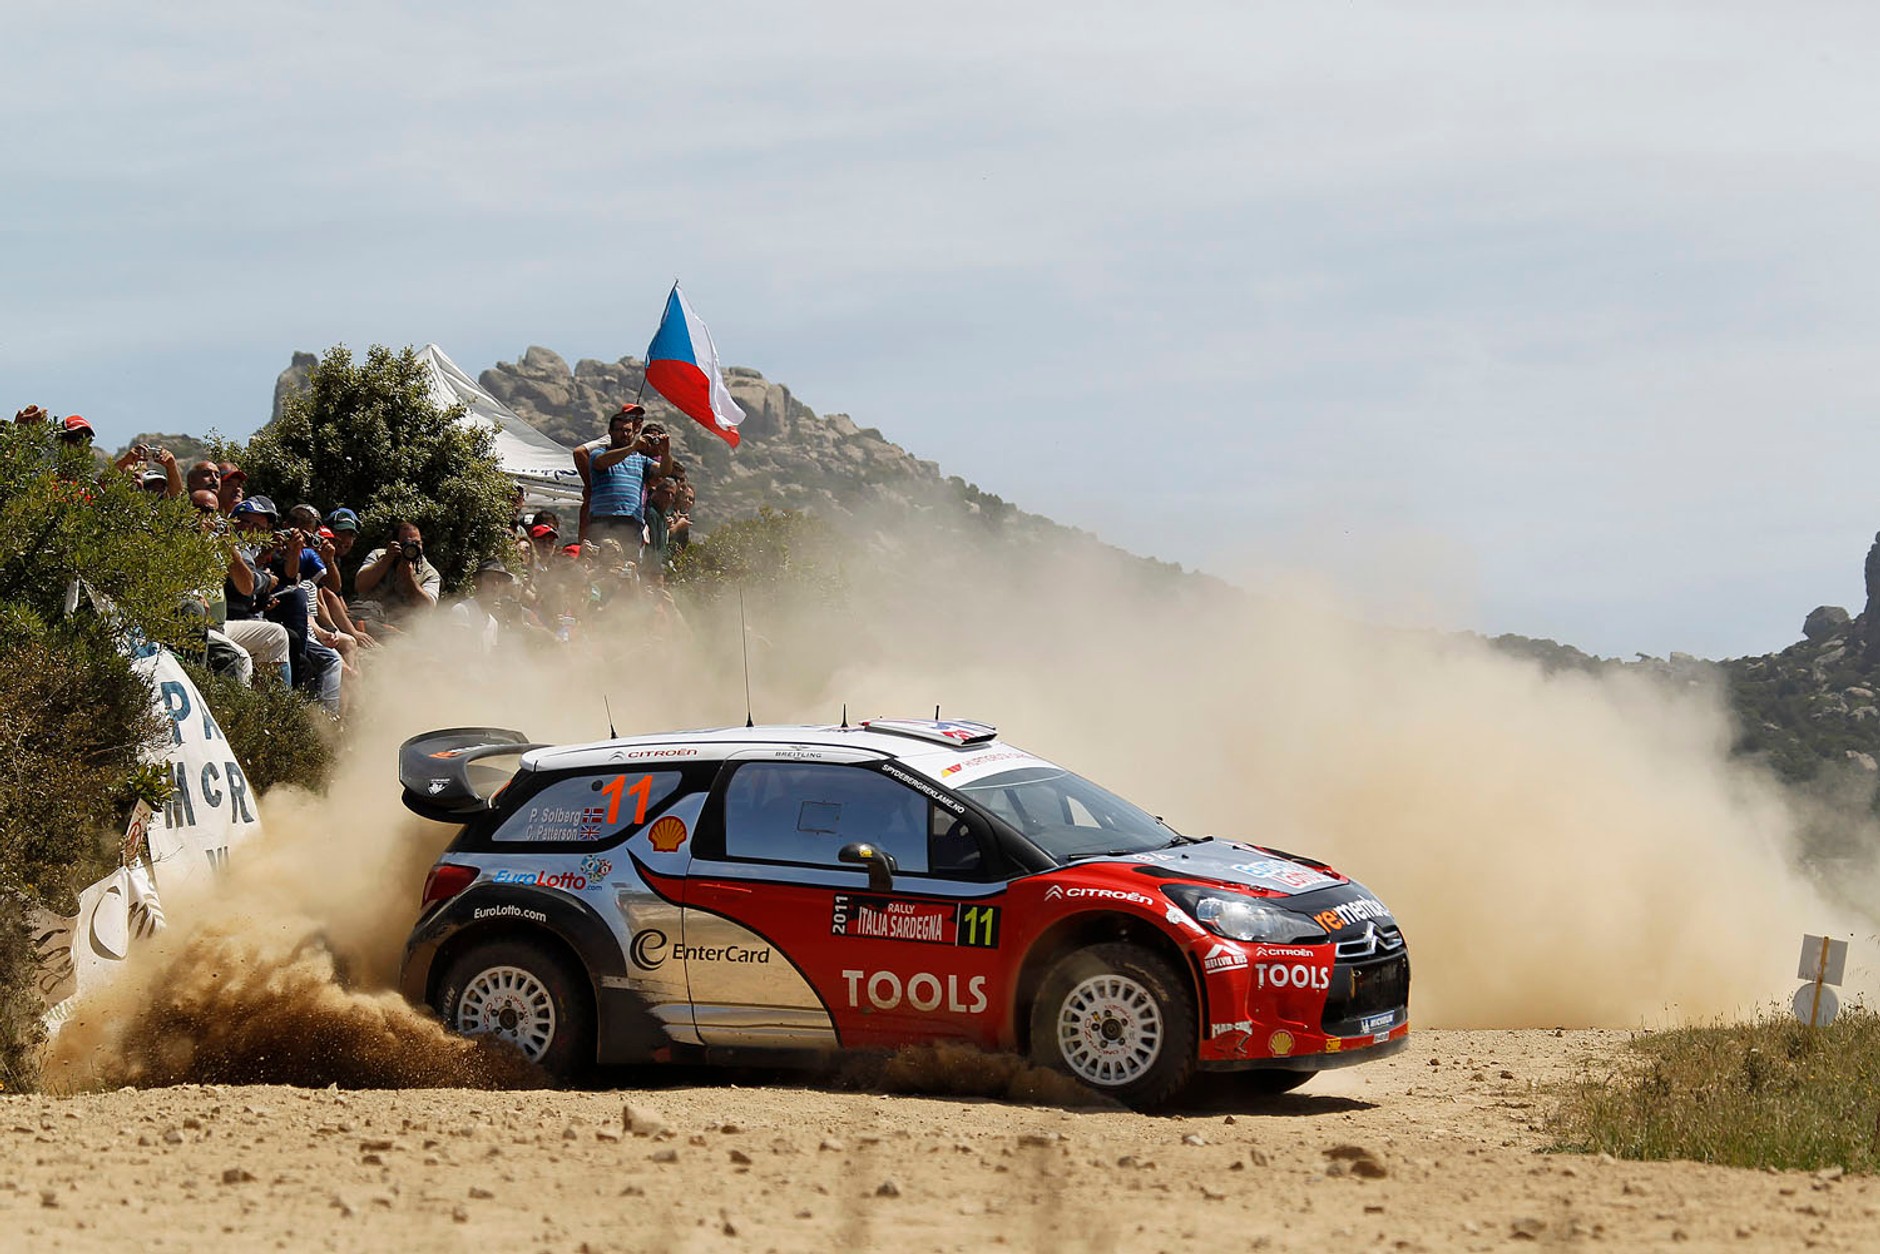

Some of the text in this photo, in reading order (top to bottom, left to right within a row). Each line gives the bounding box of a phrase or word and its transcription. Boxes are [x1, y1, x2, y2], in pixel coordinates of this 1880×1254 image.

[602, 775, 653, 824] 11
[529, 808, 581, 826] P. Solberg
[526, 825, 577, 840] C. Patterson
[1066, 888, 1153, 905] CITROËN
[474, 904, 546, 922] EuroLotto.com
[832, 896, 848, 934] 2011
[888, 903, 915, 914] RALLY
[858, 906, 942, 941] ITALIA SARDEGNA
[964, 906, 994, 946] 11
[672, 943, 770, 963] EnterCard
[1255, 963, 1330, 989] TOOLS
[842, 969, 988, 1013] TOOLS
